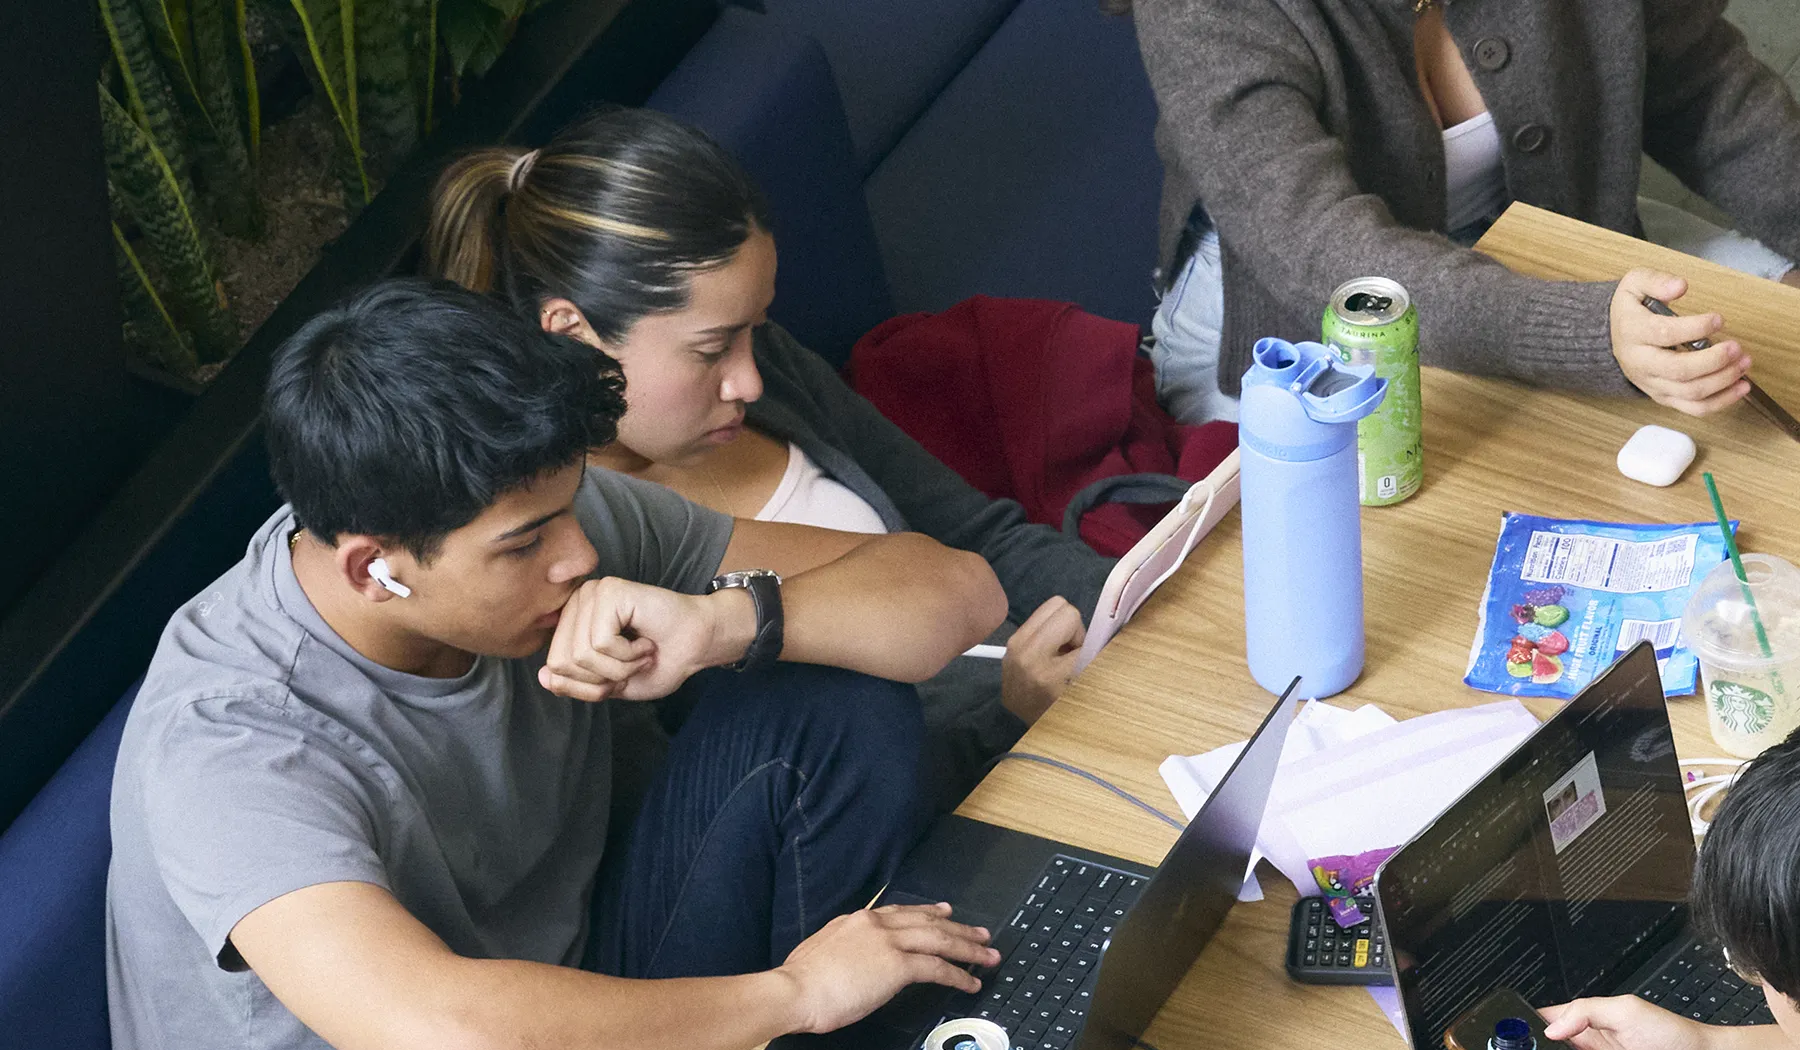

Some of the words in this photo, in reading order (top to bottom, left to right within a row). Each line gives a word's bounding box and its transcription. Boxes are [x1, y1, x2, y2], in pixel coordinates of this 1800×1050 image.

[1341, 326, 1386, 338] TAURINA
[1384, 477, 1390, 488] 0
[1526, 551, 1538, 577] Nutrition
[1555, 556, 1566, 579] Calories
[1561, 537, 1571, 550] 100
[1581, 600, 1598, 630] FLAVOR
[1574, 631, 1590, 658] FRUIT
[1589, 626, 1602, 656] ORIGINAL
